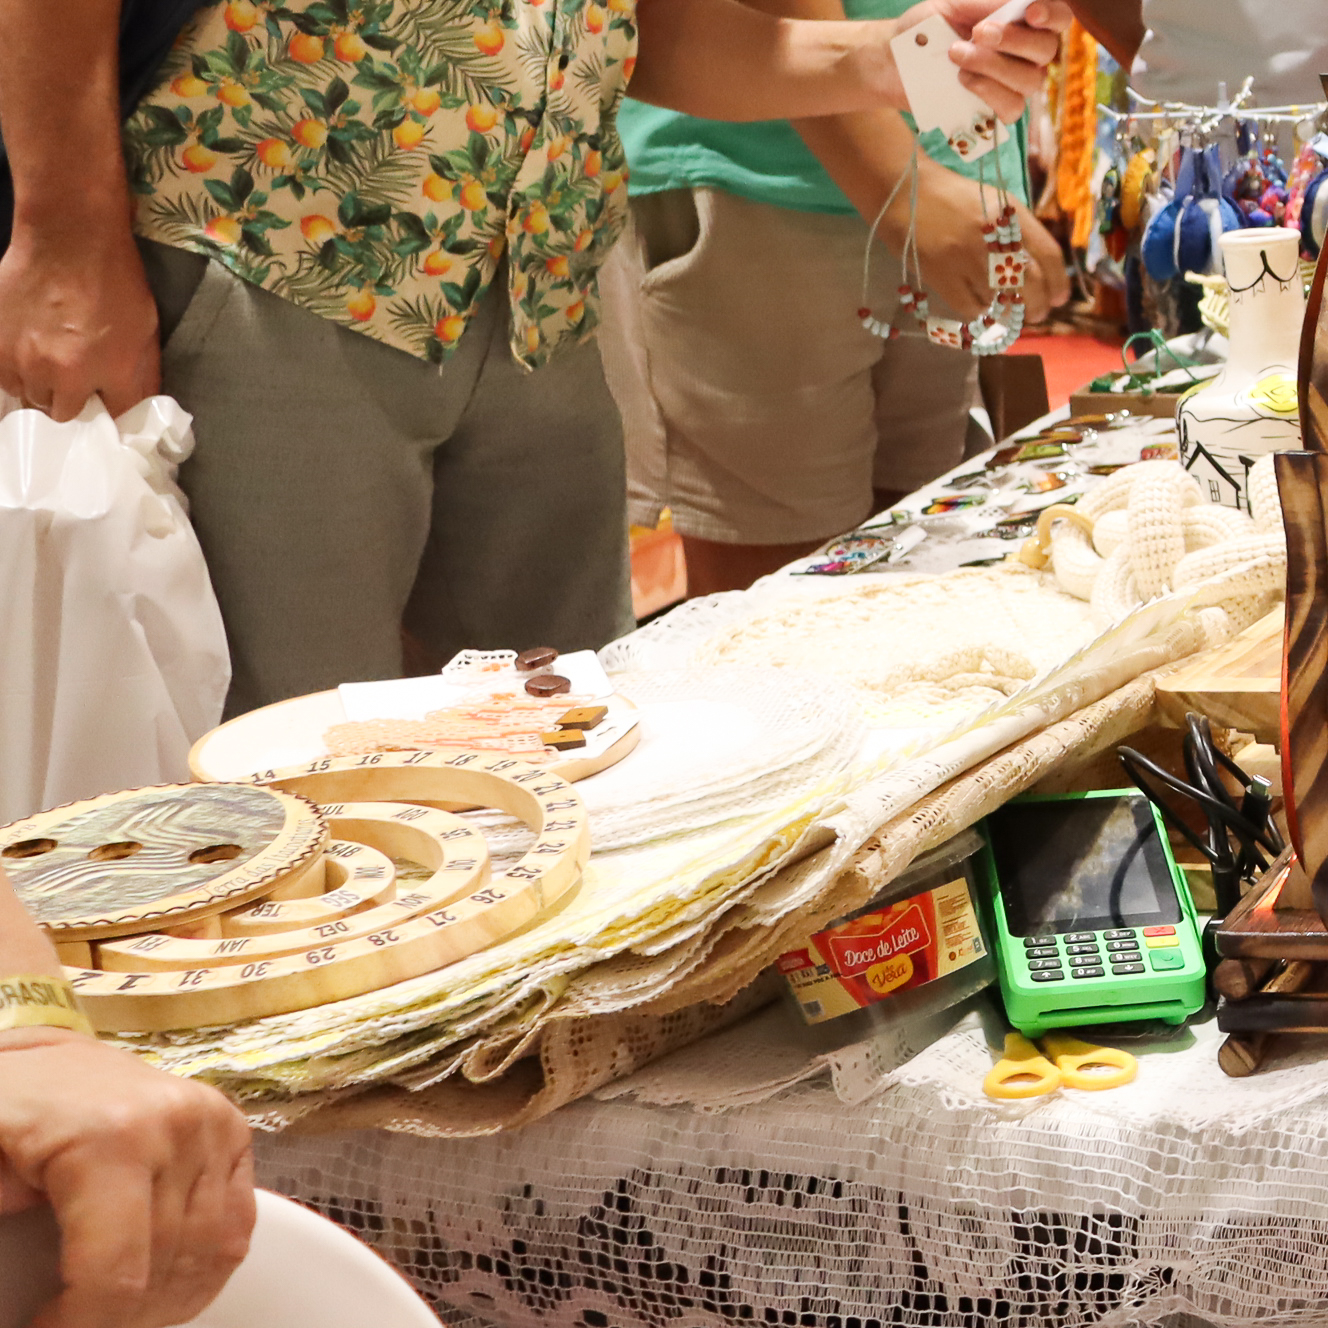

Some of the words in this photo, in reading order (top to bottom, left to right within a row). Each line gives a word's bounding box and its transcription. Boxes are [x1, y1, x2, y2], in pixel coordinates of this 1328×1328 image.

[356, 754, 383, 765] 16
[403, 751, 434, 764] 17
[444, 754, 478, 766] 18
[485, 759, 518, 771] 19
[306, 760, 332, 772] 15
[251, 769, 277, 783] 14
[512, 770, 546, 782] 20
[533, 781, 567, 796] 21
[546, 798, 578, 812] 22
[391, 808, 429, 821] AGO
[544, 820, 577, 832] 23
[532, 842, 565, 855] 24
[506, 865, 542, 879] 25
[320, 889, 361, 908] SEG
[393, 893, 432, 909] NOV
[470, 889, 505, 904] 26
[250, 904, 284, 917] TER
[425, 910, 457, 927] 27
[313, 922, 349, 938] DEZ
[128, 935, 170, 951] FEV
[367, 930, 399, 946] 28
[214, 938, 250, 954] JAN
[844, 949, 876, 967] Doce
[876, 940, 893, 959] de
[892, 926, 920, 953] Leite
[306, 946, 337, 964] 29
[240, 961, 275, 979] 30
[872, 964, 907, 988] Vera
[116, 975, 151, 990] 1
[178, 969, 210, 987] 31
[0, 982, 67, 1009] RASIL
